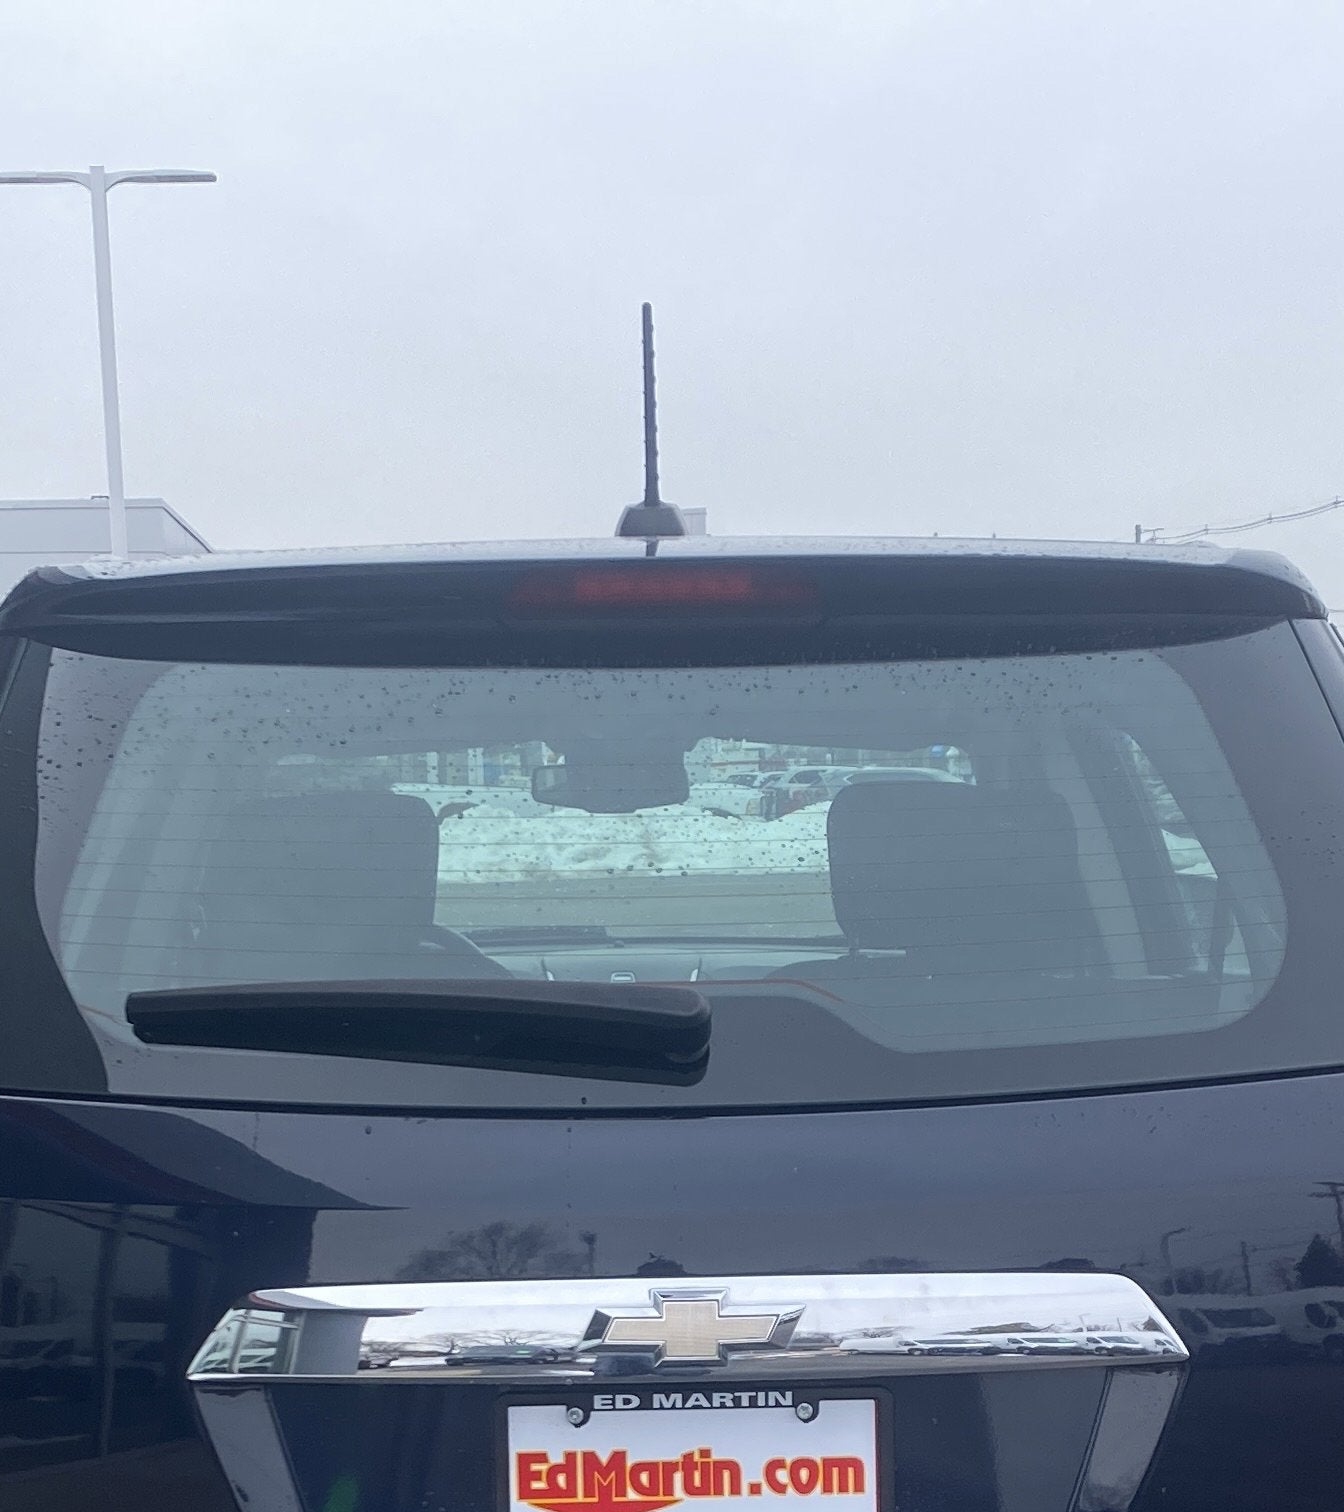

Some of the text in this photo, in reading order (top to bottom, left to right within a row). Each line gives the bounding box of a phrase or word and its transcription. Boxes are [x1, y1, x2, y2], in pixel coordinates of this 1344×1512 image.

[593, 1391, 794, 1411] ED MARTIN
[515, 1447, 866, 1505] EdMartin.com
